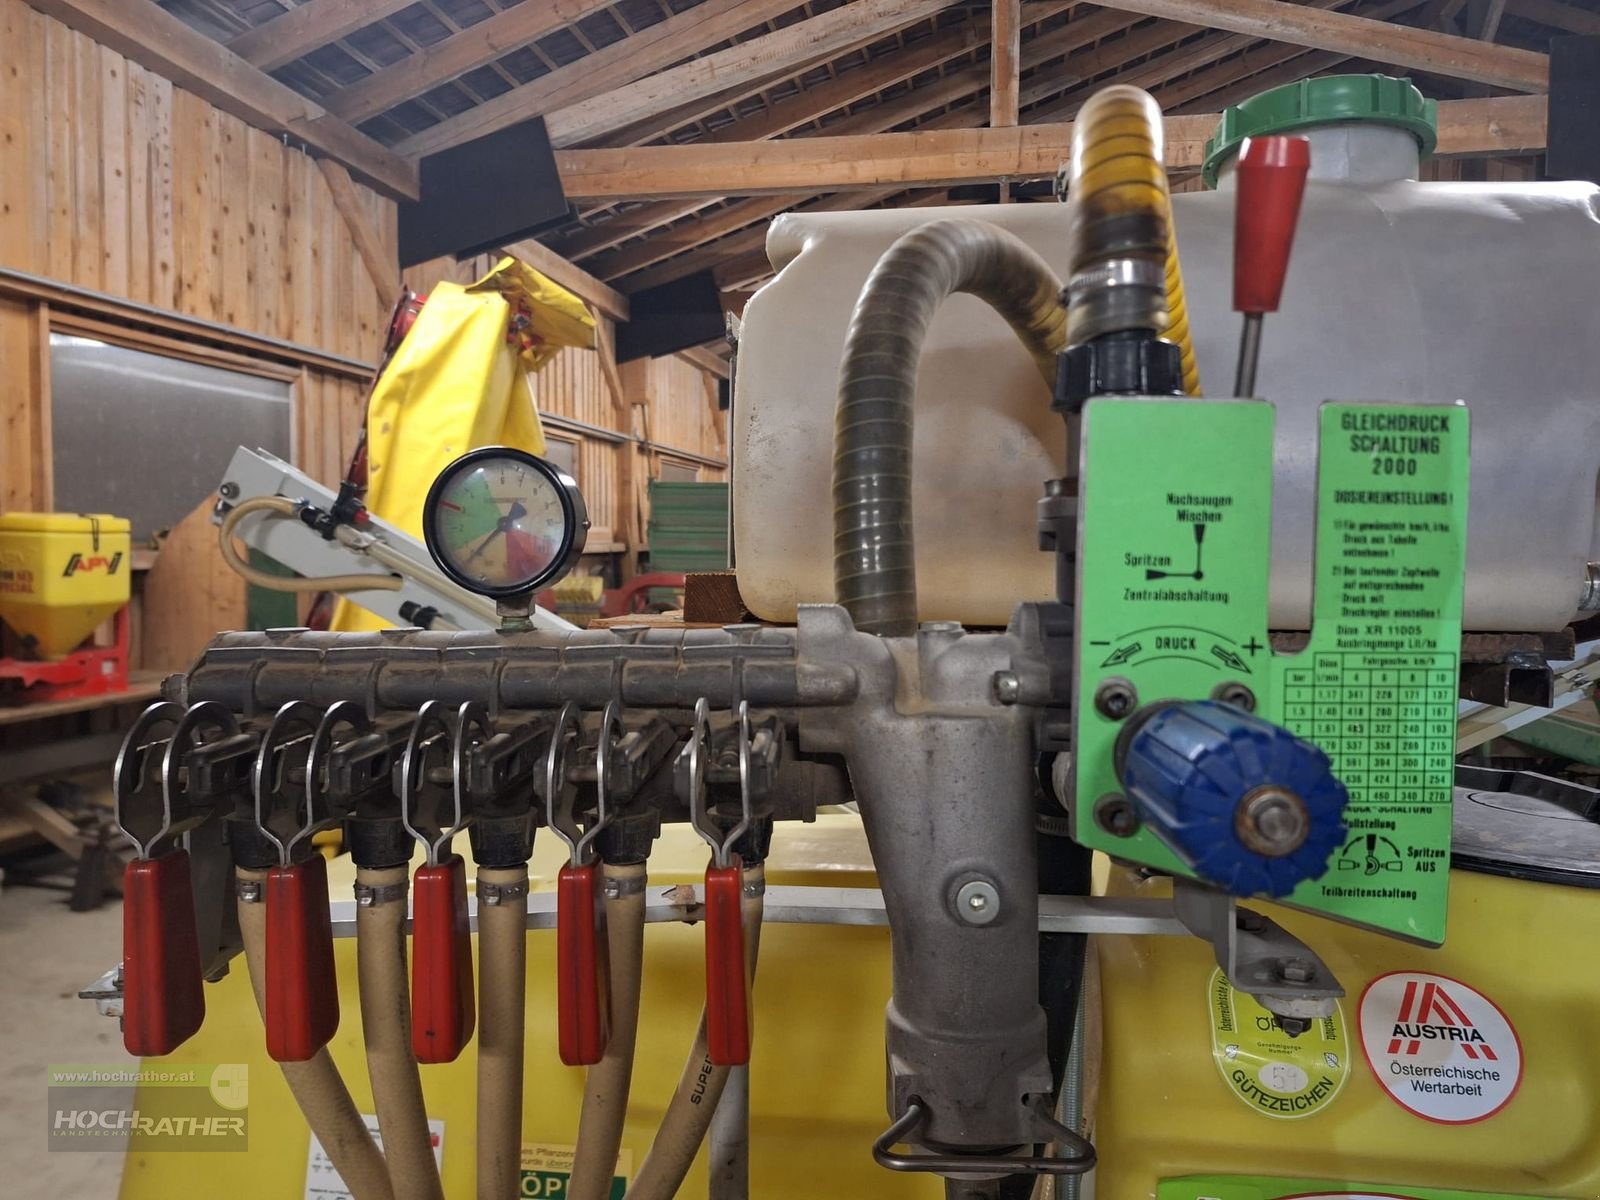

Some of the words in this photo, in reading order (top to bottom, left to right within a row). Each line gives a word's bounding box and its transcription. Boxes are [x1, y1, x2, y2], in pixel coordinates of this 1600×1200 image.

[1341, 413, 1450, 432] GLEICHDRUCK
[1351, 435, 1440, 454] SCHALTUNG
[1372, 458, 1417, 476] 2000
[1166, 493, 1233, 508] Nachsaugen
[1177, 509, 1222, 522] Mischen
[1343, 534, 1367, 544] Druck
[62, 551, 122, 577] APV
[1124, 552, 1171, 567] Spritzen
[1123, 588, 1230, 604] Zentralabschaltung
[1342, 594, 1366, 603] Druck
[1366, 625, 1382, 635] XR
[1389, 625, 1422, 636] 11005
[1155, 636, 1196, 650] DRUCK
[1376, 724, 1391, 733] 322
[1403, 724, 1419, 733] 240
[1431, 741, 1446, 750] 215
[1430, 758, 1446, 767] 240
[1374, 775, 1390, 784] 424
[1430, 775, 1445, 784] 254
[1407, 846, 1446, 859] Spritzen
[1415, 861, 1436, 872] AUS
[1321, 886, 1417, 901] Teilbreitenschaltung
[1392, 1024, 1486, 1043] AUSTRIA
[1390, 1060, 1500, 1081] Österreichische
[1232, 1069, 1334, 1112] GÜTEZEICHEN
[1411, 1080, 1482, 1096] Wertarbeit
[522, 1171, 569, 1197] ÖP
